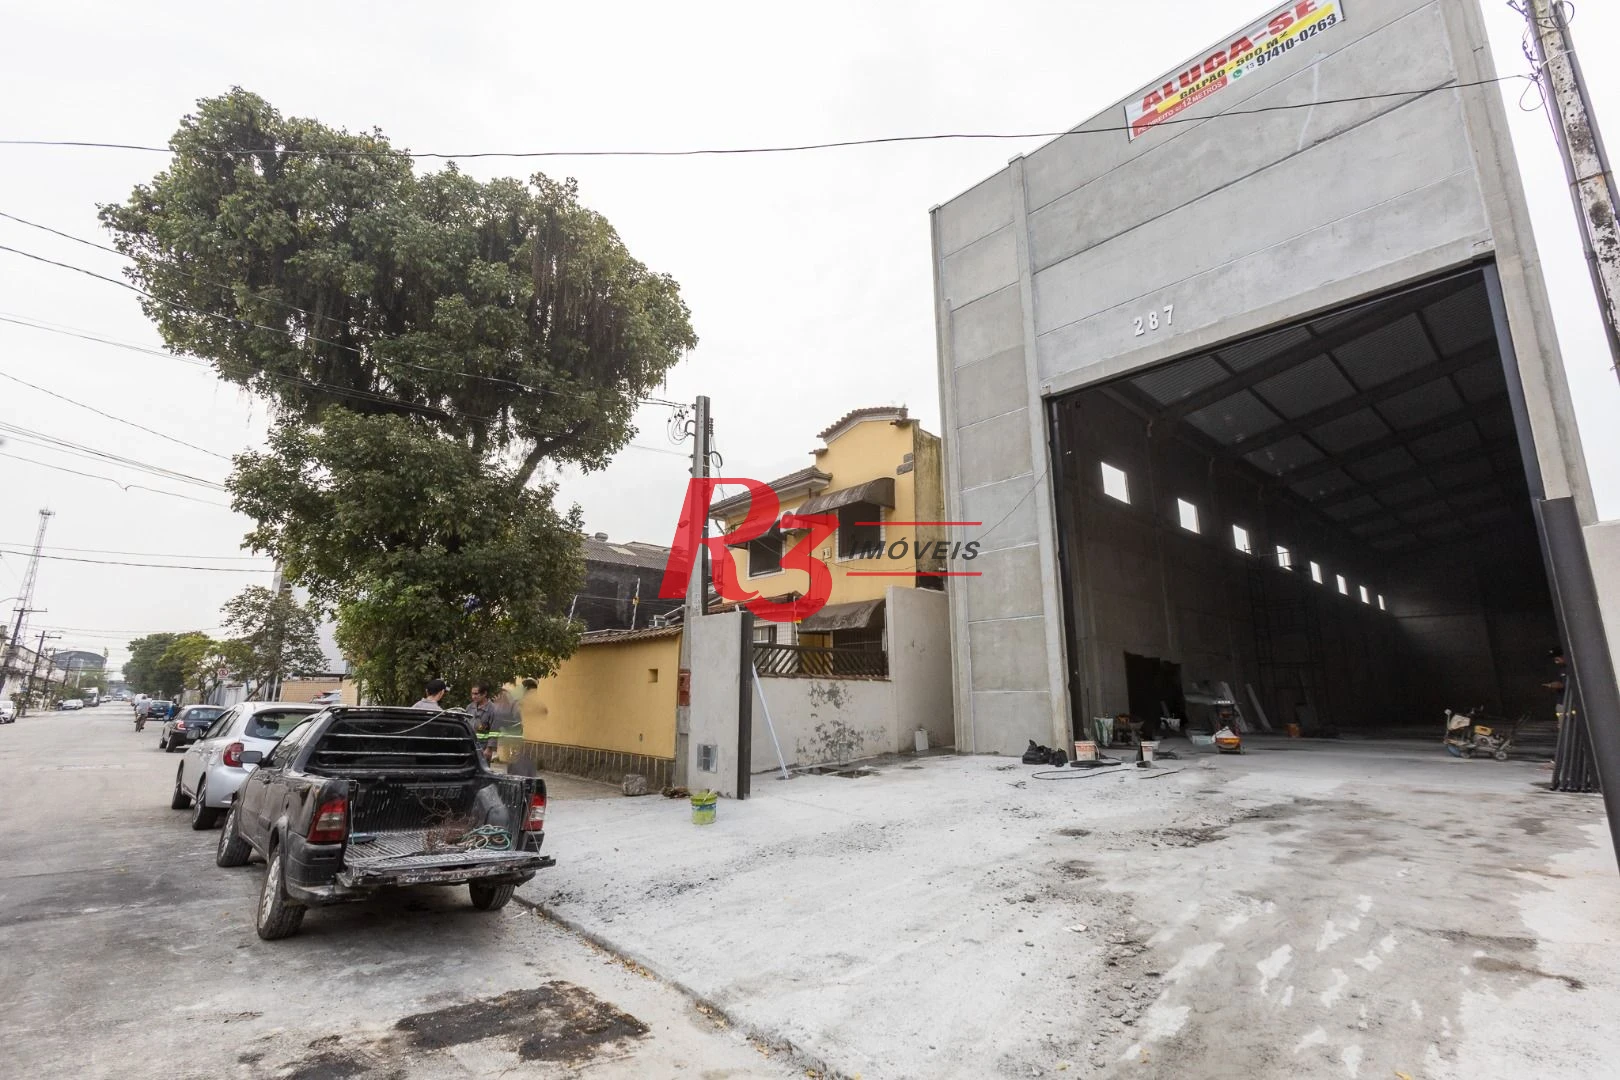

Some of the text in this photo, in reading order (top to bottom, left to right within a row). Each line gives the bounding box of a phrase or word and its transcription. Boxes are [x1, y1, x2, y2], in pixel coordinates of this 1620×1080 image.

[1142, 0, 1317, 112] ALUGA-SE
[1256, 13, 1337, 67] 97410-0263
[1236, 47, 1263, 67] 500
[1182, 98, 1192, 108] 12
[1192, 81, 1223, 103] METROS
[1133, 304, 1174, 337] 287
